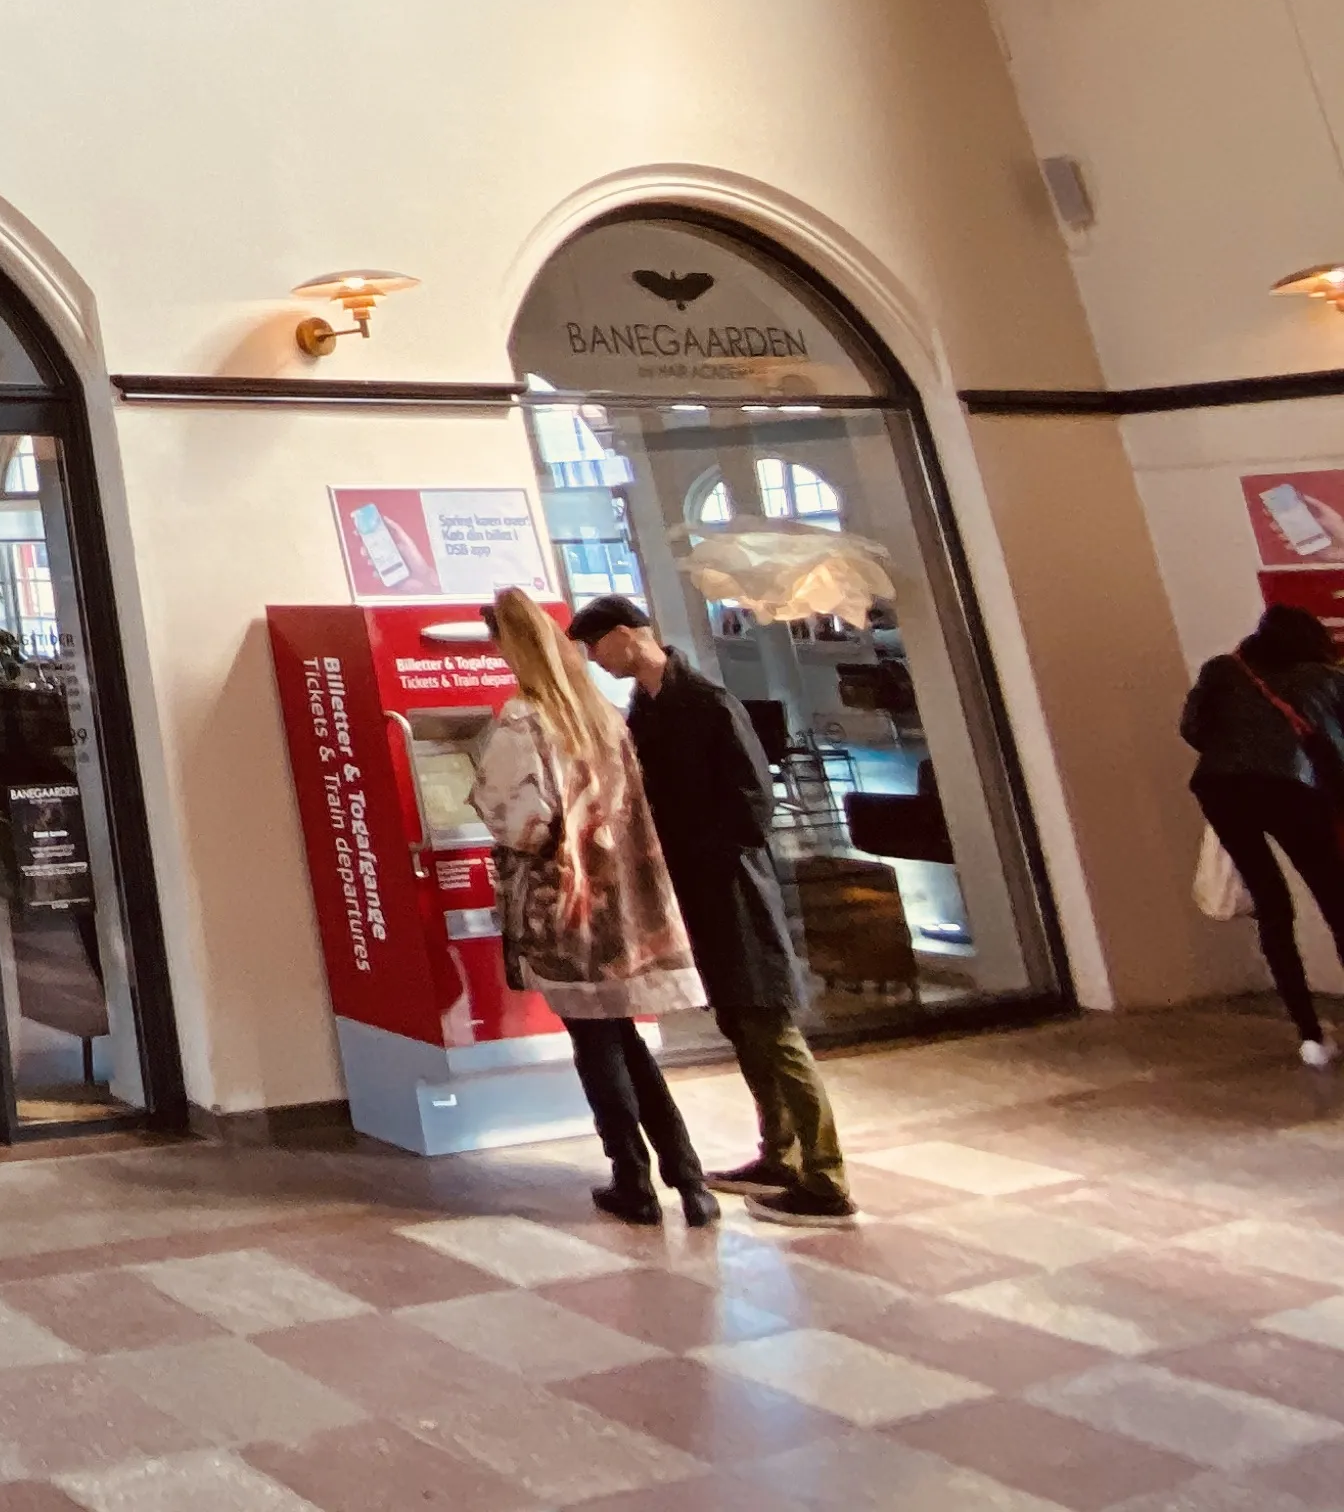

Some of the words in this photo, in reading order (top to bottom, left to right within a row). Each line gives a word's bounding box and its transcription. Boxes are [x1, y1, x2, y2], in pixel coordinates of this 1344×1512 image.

[566, 322, 808, 357] BANEGAARDEN
[396, 657, 442, 672] Billetter
[444, 656, 455, 670] &
[400, 675, 439, 689] Tickets
[440, 675, 452, 688] &
[452, 674, 481, 687] Train
[303, 656, 329, 737] Tickets
[322, 657, 353, 757] Billetter
[318, 745, 336, 763] &
[342, 762, 361, 783] &
[321, 772, 346, 829] Train
[348, 789, 387, 941] Togafgange
[335, 836, 372, 972] departures
